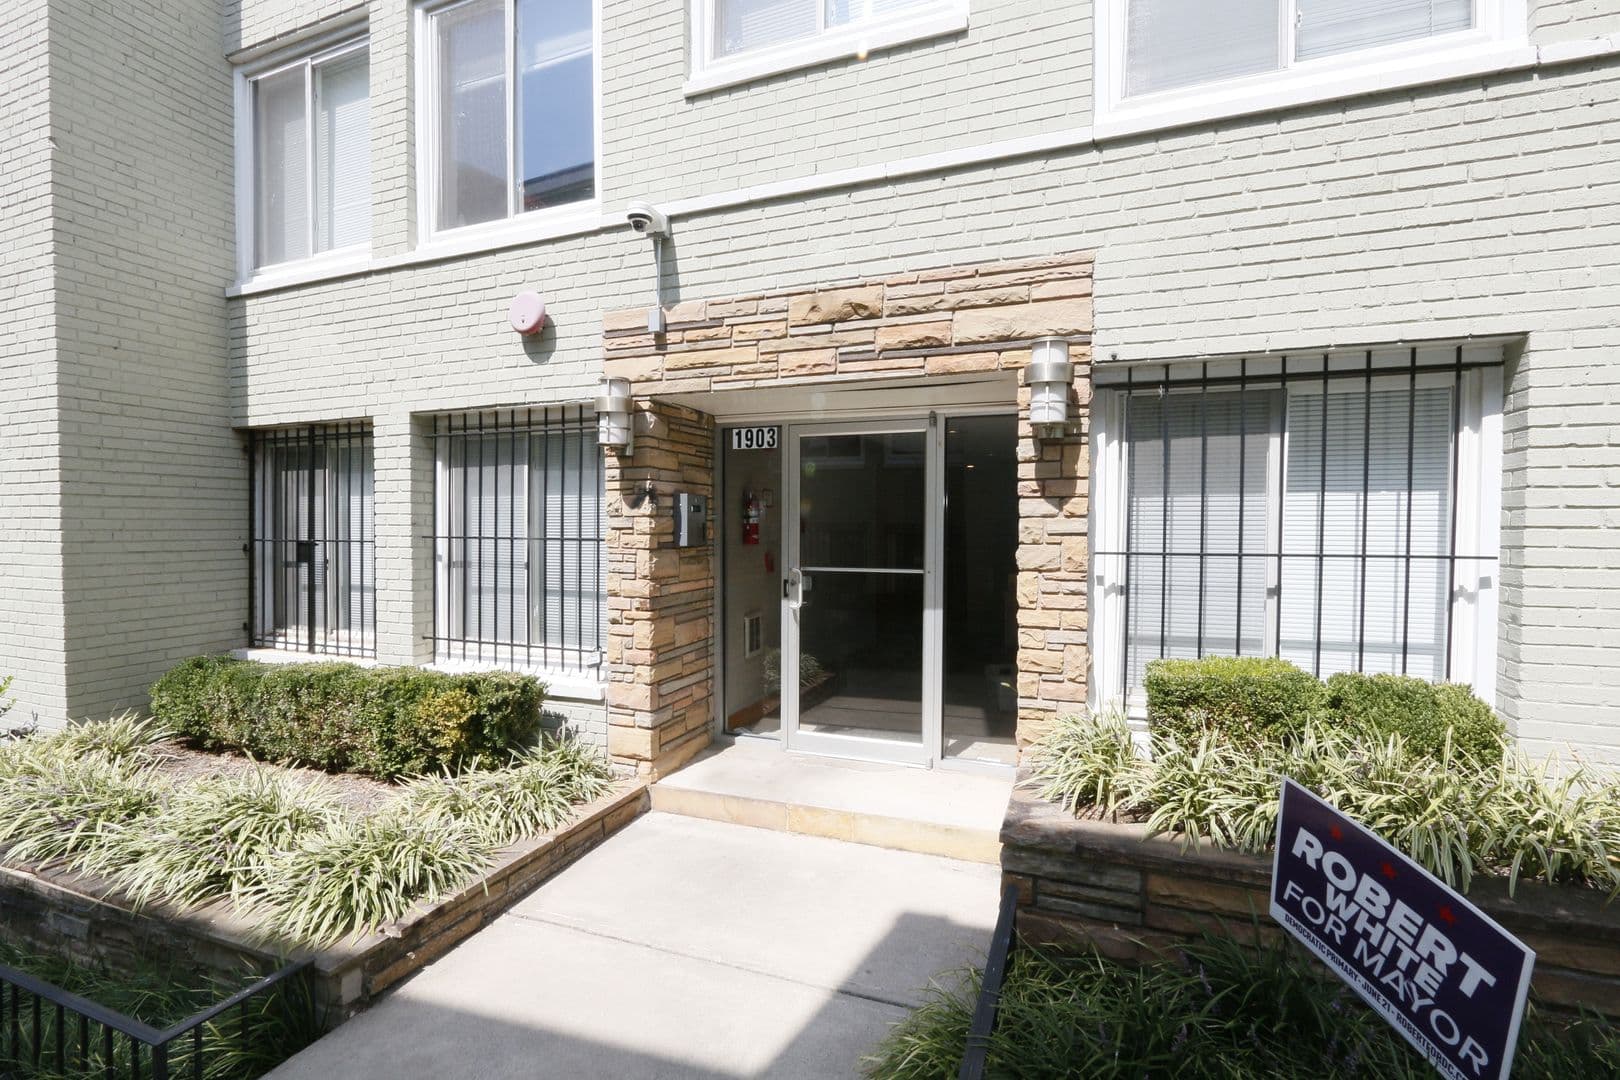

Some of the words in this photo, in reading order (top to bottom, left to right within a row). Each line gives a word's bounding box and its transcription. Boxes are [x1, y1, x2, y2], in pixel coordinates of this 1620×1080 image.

[735, 428, 776, 449] 1903
[1284, 913, 1327, 954] DEMOCRATIC
[1326, 949, 1359, 983] PRIMARY
[1361, 981, 1382, 1004] JUNE
[1381, 998, 1393, 1012] 21
[1291, 827, 1497, 998] ROBERT
[1325, 883, 1445, 998] WHITE
[1283, 880, 1347, 945] FOR
[1353, 937, 1489, 1077] MAYOR
